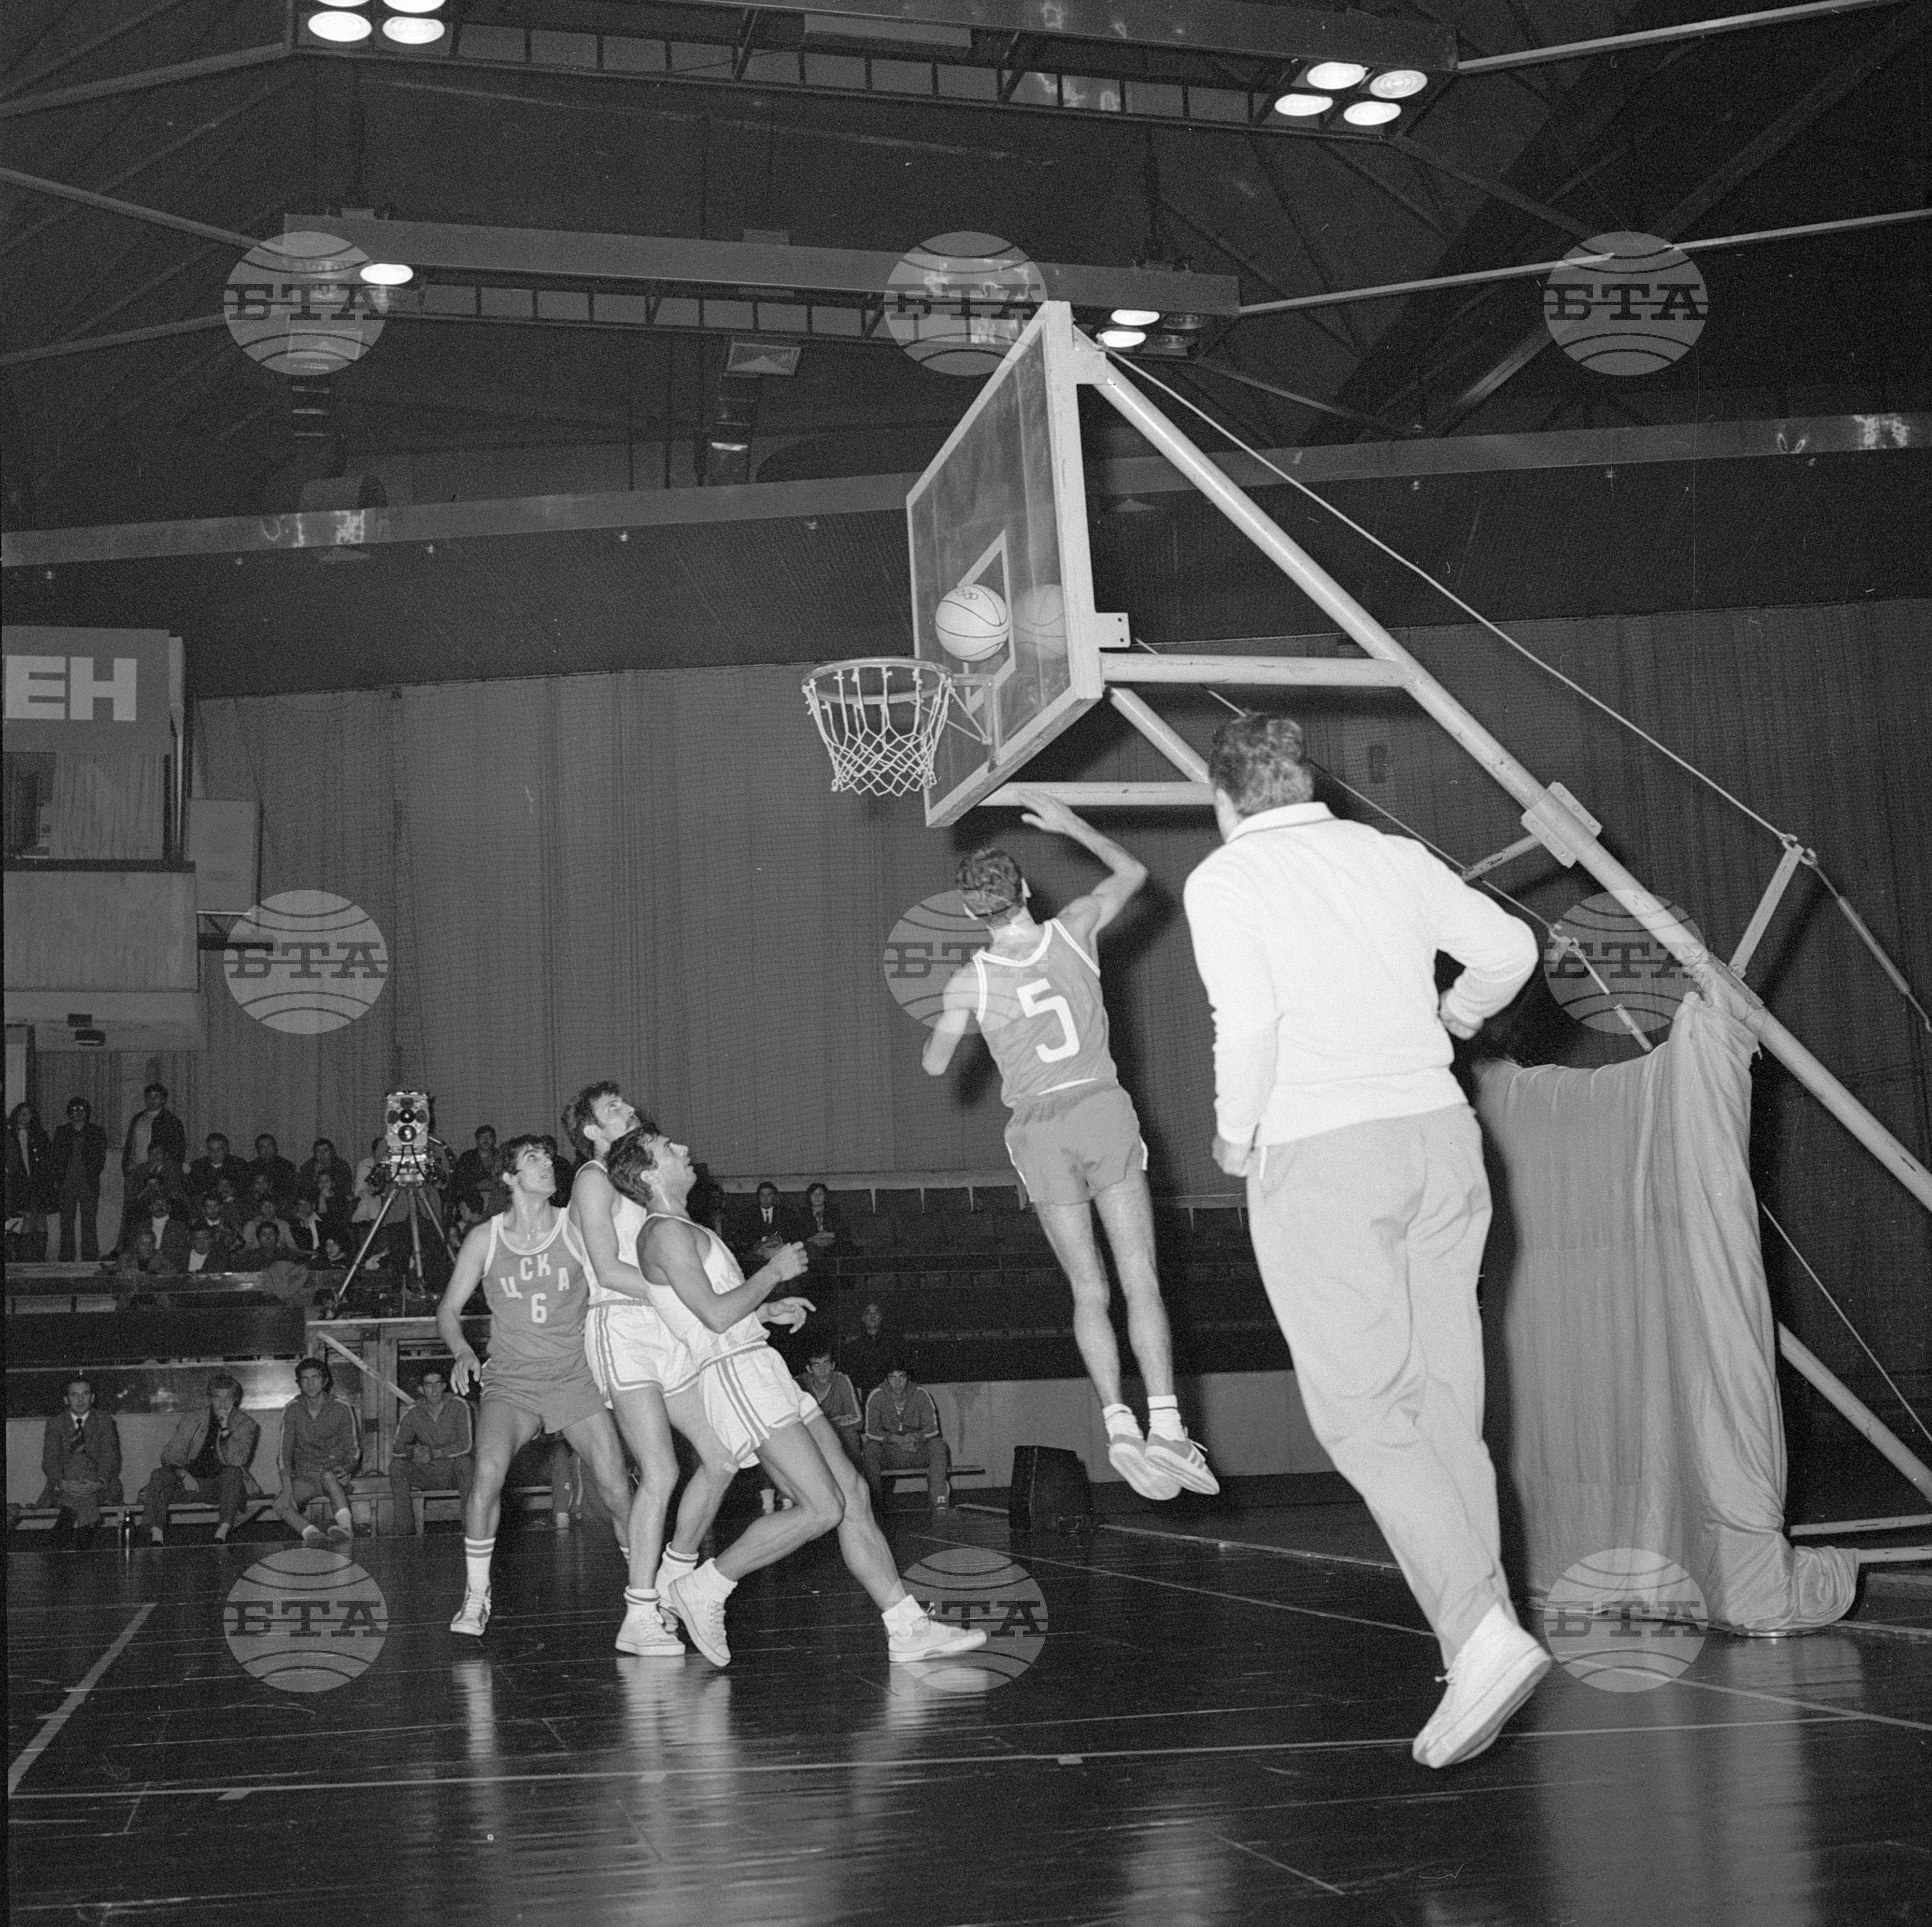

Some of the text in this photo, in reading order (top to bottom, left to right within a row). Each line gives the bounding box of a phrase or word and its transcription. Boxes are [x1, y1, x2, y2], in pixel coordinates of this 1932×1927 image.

[2, 655, 137, 721] ЕН
[1016, 977, 1080, 1063] 5
[500, 1254, 570, 1299] ЦСКА
[531, 1293, 547, 1323] 6
